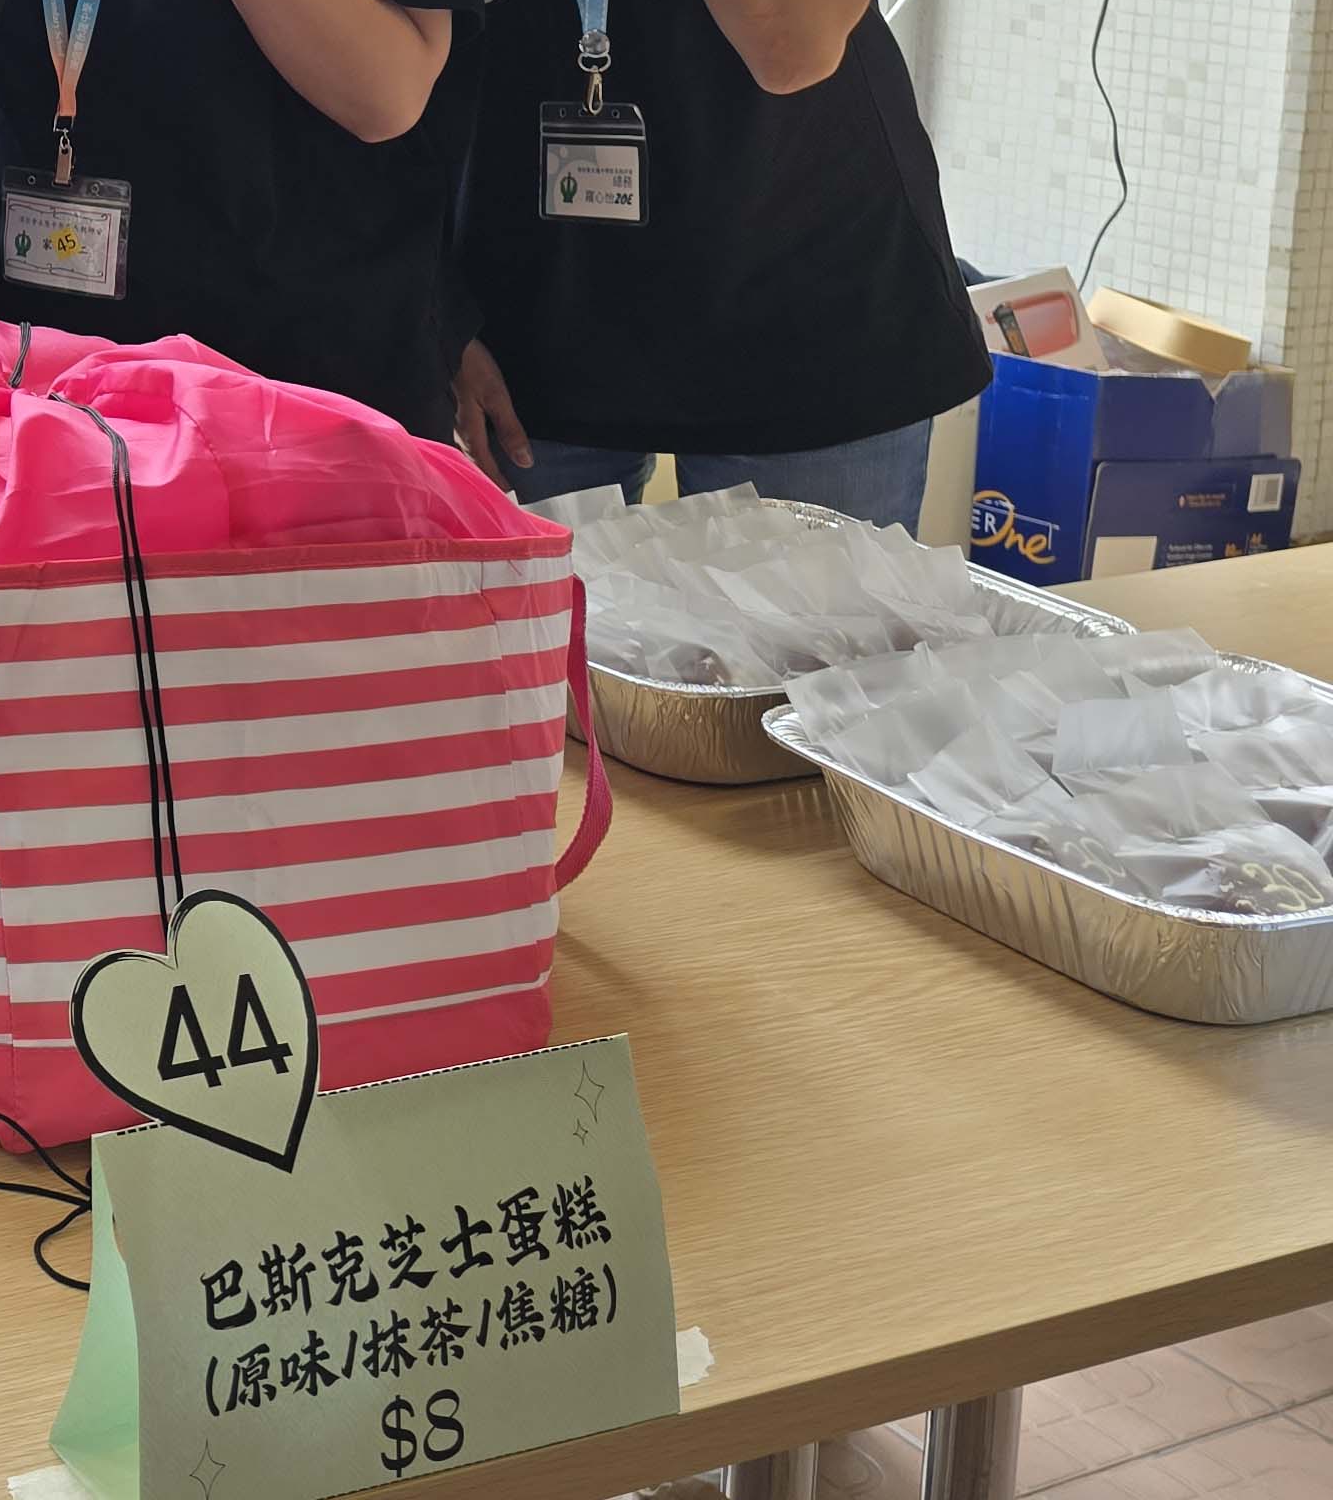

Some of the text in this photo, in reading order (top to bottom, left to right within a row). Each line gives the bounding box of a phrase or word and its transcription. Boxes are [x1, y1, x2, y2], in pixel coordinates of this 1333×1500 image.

[56, 233, 76, 253] 45
[156, 974, 294, 1088] 44
[199, 1175, 613, 1332] 巴斯克芝士蛋糕
[205, 1263, 618, 1418] (原味/抹茶/焦糖)
[380, 1388, 466, 1477] $8
